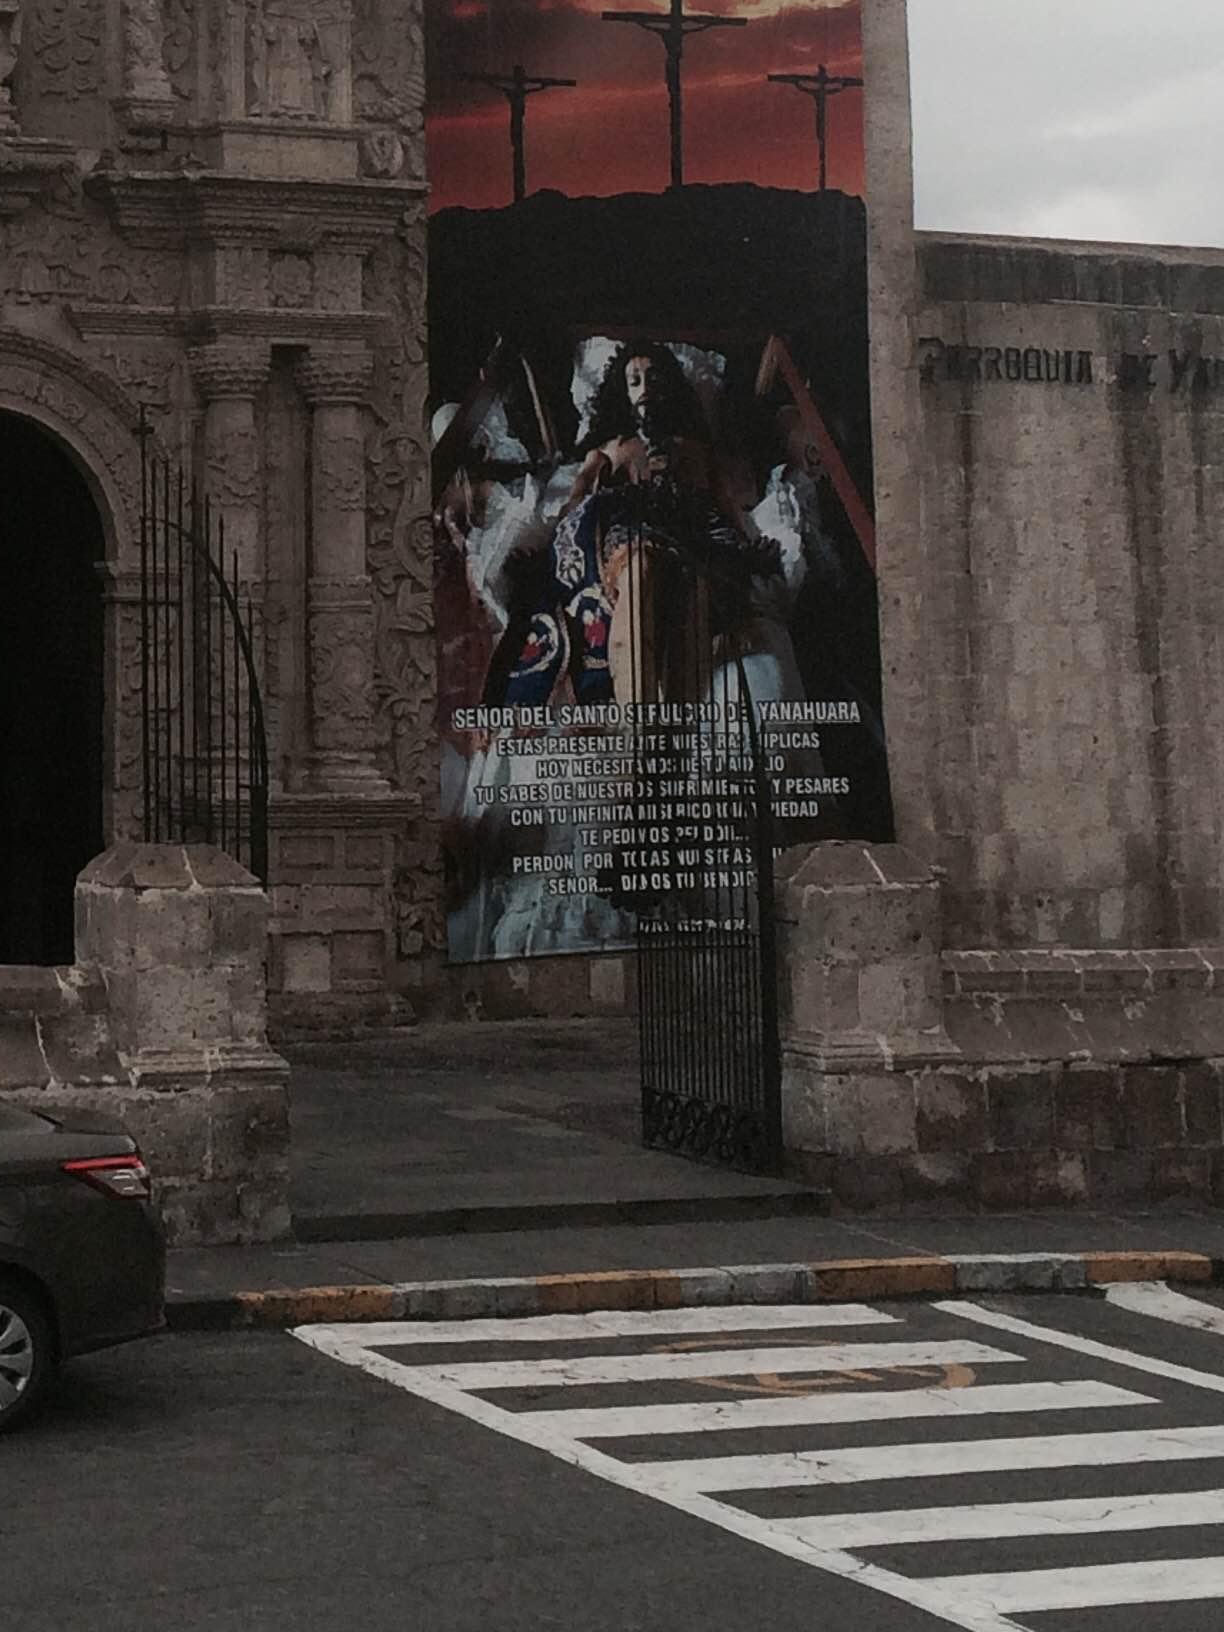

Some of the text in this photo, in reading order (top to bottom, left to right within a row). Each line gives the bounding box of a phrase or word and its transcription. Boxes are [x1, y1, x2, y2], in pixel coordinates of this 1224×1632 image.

[454, 703, 514, 729] SEÑOR
[519, 705, 555, 726] DEL
[560, 703, 620, 726] SANTO
[758, 701, 861, 722] YANAHUARA
[497, 737, 545, 756] ESTAS
[548, 735, 624, 753] PRESENTE
[536, 759, 568, 777] HOY
[476, 786, 494, 804] TU
[499, 784, 549, 803] SABES
[552, 783, 572, 801] DE
[771, 778, 781, 794] Y
[786, 777, 850, 794] PESARES
[511, 809, 543, 826] CON
[548, 808, 566, 825] TU
[572, 804, 634, 824] INFINITA
[580, 829, 598, 846] TE
[512, 854, 574, 873] PERDON
[583, 852, 614, 870] POR
